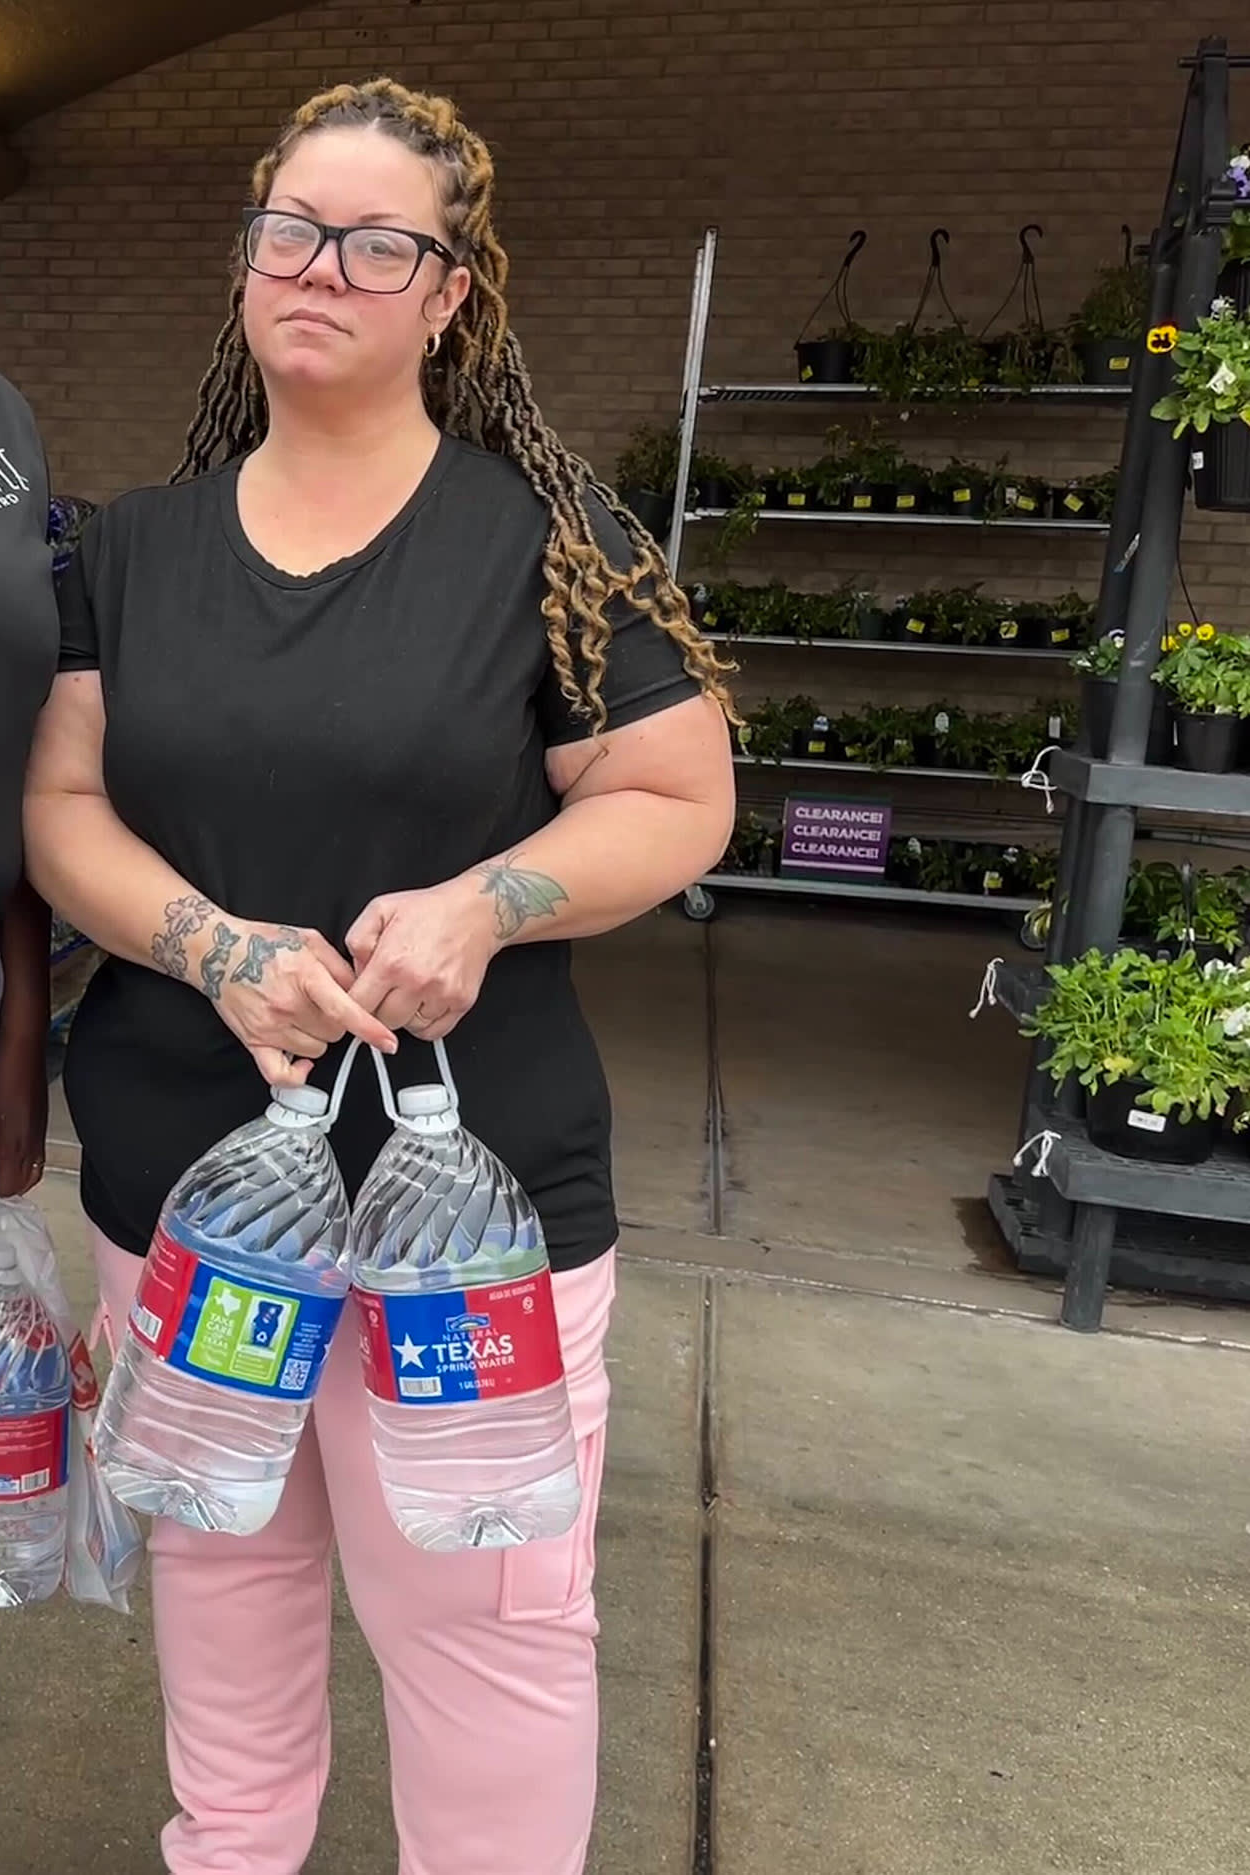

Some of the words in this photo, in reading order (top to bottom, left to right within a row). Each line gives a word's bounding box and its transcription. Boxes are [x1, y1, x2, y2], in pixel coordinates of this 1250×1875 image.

[795, 807, 883, 824] CLEARANCE!
[793, 824, 881, 841] CLEARANCE!
[791, 842, 879, 859] CLEARANCE!
[206, 1320, 233, 1336] CARE
[442, 1327, 499, 1341] NATURAL
[431, 1334, 513, 1363] TEXAS
[436, 1361, 477, 1374] SPRING
[477, 1355, 515, 1369] WATER
